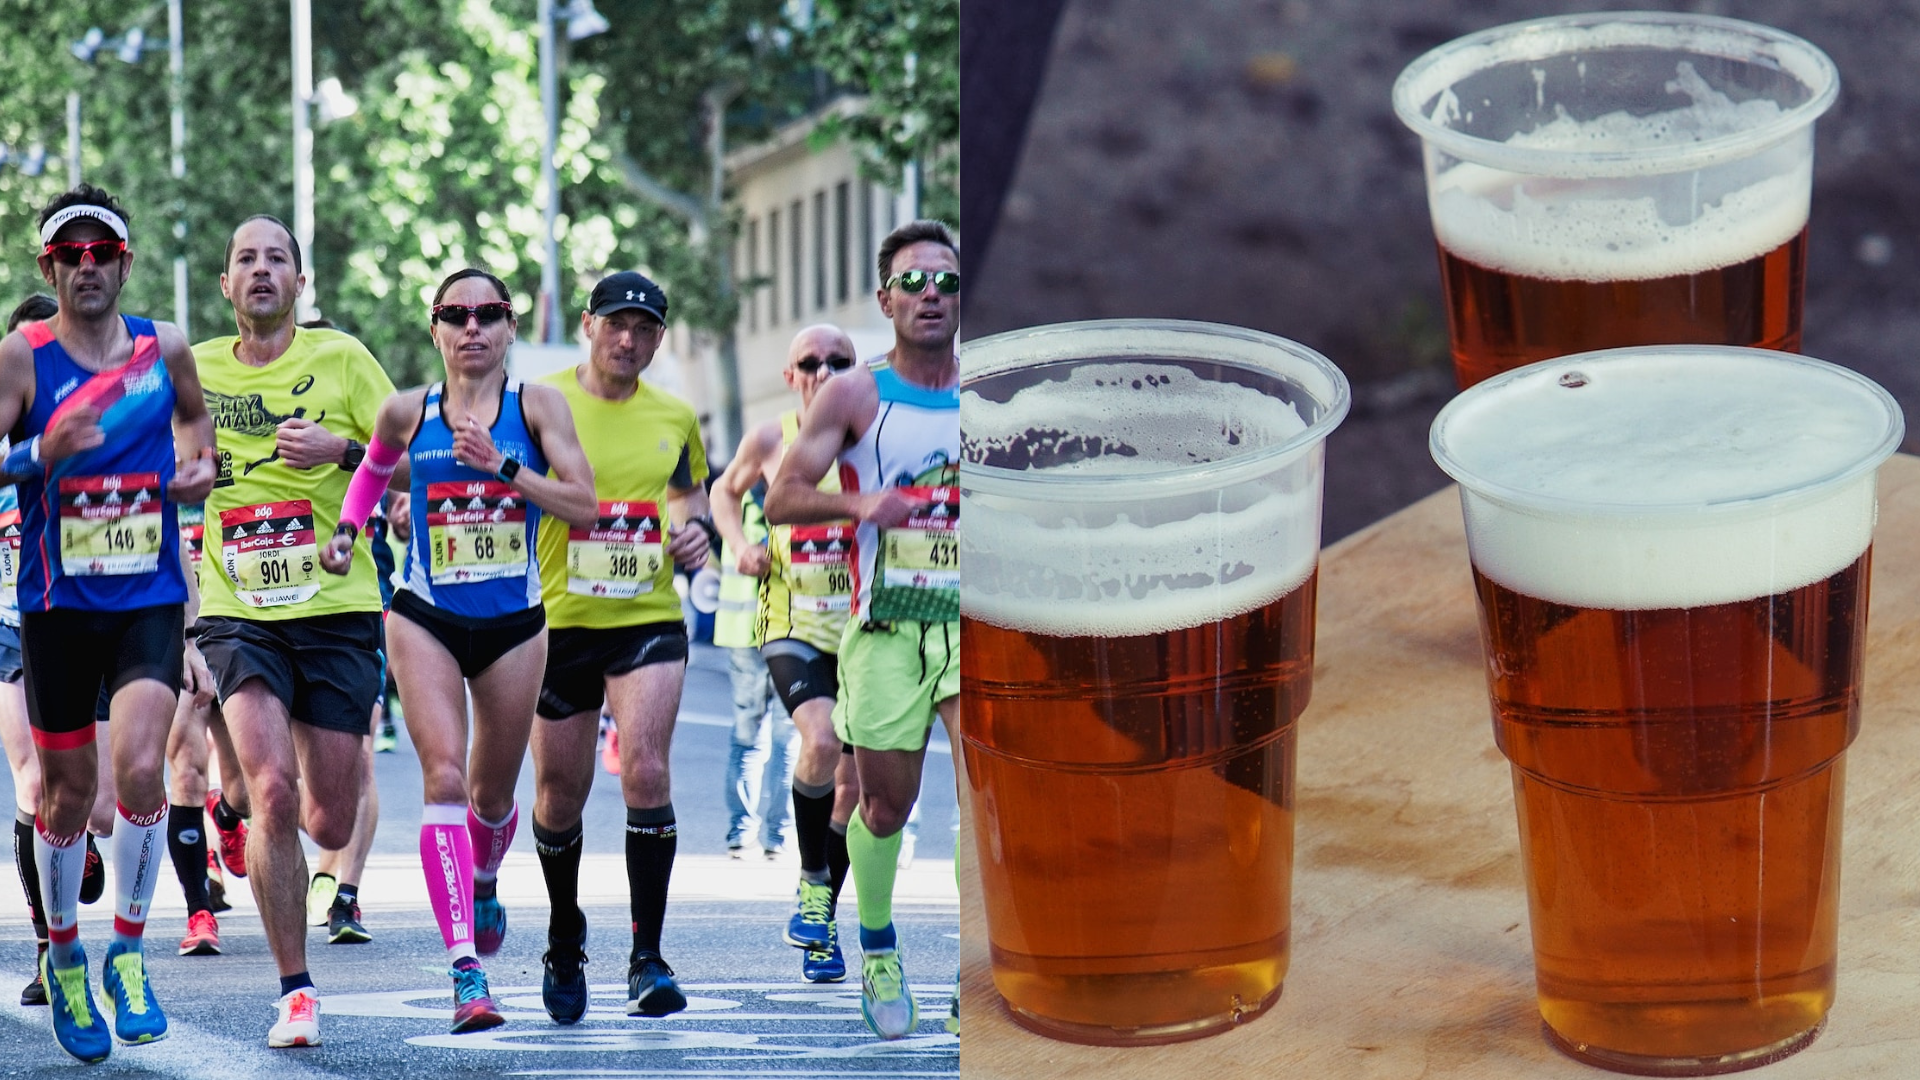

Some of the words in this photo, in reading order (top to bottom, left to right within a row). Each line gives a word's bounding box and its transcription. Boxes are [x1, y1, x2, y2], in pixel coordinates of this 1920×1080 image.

[255, 505, 273, 518] edp
[105, 526, 135, 551] 146
[447, 537, 457, 562] F
[475, 536, 494, 560] 68
[260, 550, 280, 559] JORDI
[610, 554, 637, 577] 388
[930, 542, 958, 566] 431
[261, 559, 290, 585] 901
[266, 593, 299, 603] HUAWEI
[132, 828, 154, 902] COMPRESSPORT
